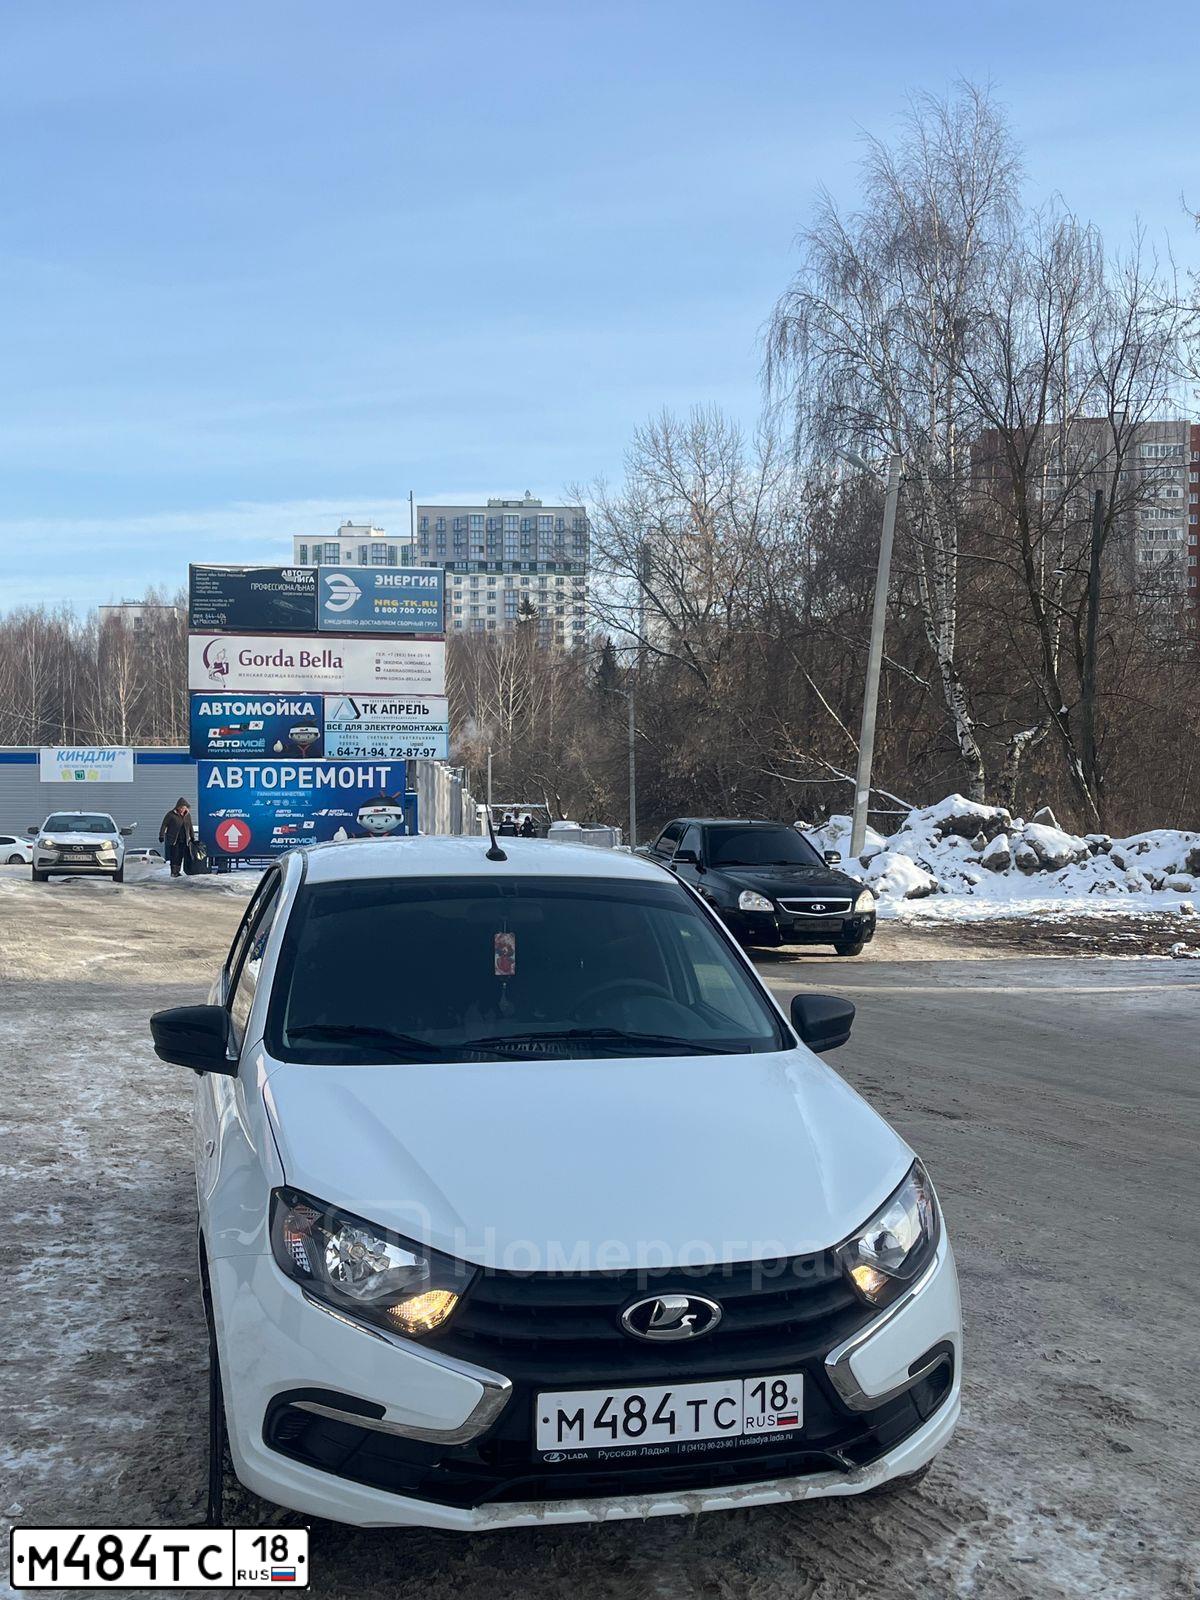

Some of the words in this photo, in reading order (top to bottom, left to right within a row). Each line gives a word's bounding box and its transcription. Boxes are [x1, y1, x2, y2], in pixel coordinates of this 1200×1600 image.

[250, 582, 315, 592] ПРОФЕССИОНАЛЬНАЯ
[374, 575, 438, 587] ЭНЕРГИЯ
[374, 599, 438, 608] NRG-TK.RU
[416, 607, 438, 615] 7000
[238, 649, 296, 668] Gorda
[299, 650, 344, 669] Bella
[198, 699, 315, 716] АВТОМОЙКА
[361, 703, 378, 715] ТК
[380, 703, 430, 715] АПРЕЛЬ
[344, 723, 362, 732] ДЛЯ
[364, 723, 444, 732] ЭЛЕКТРОМОНТАЖА
[56, 750, 117, 764] КИНДЛИ
[336, 747, 387, 758] 64-71-94,
[389, 748, 437, 758] 72-87-97
[206, 766, 391, 789] АВТОРЕМОНТ
[557, 1392, 737, 1443] М484ТС
[750, 1379, 788, 1414] 18
[746, 1414, 776, 1429] RUS
[597, 1448, 637, 1461] Русская
[640, 1446, 670, 1457] Ладья
[687, 1442, 707, 1453] (3412)
[707, 1439, 734, 1450] 90-23-90
[739, 1432, 794, 1447] rusladya.lada.ru
[566, 1451, 588, 1461] LADA
